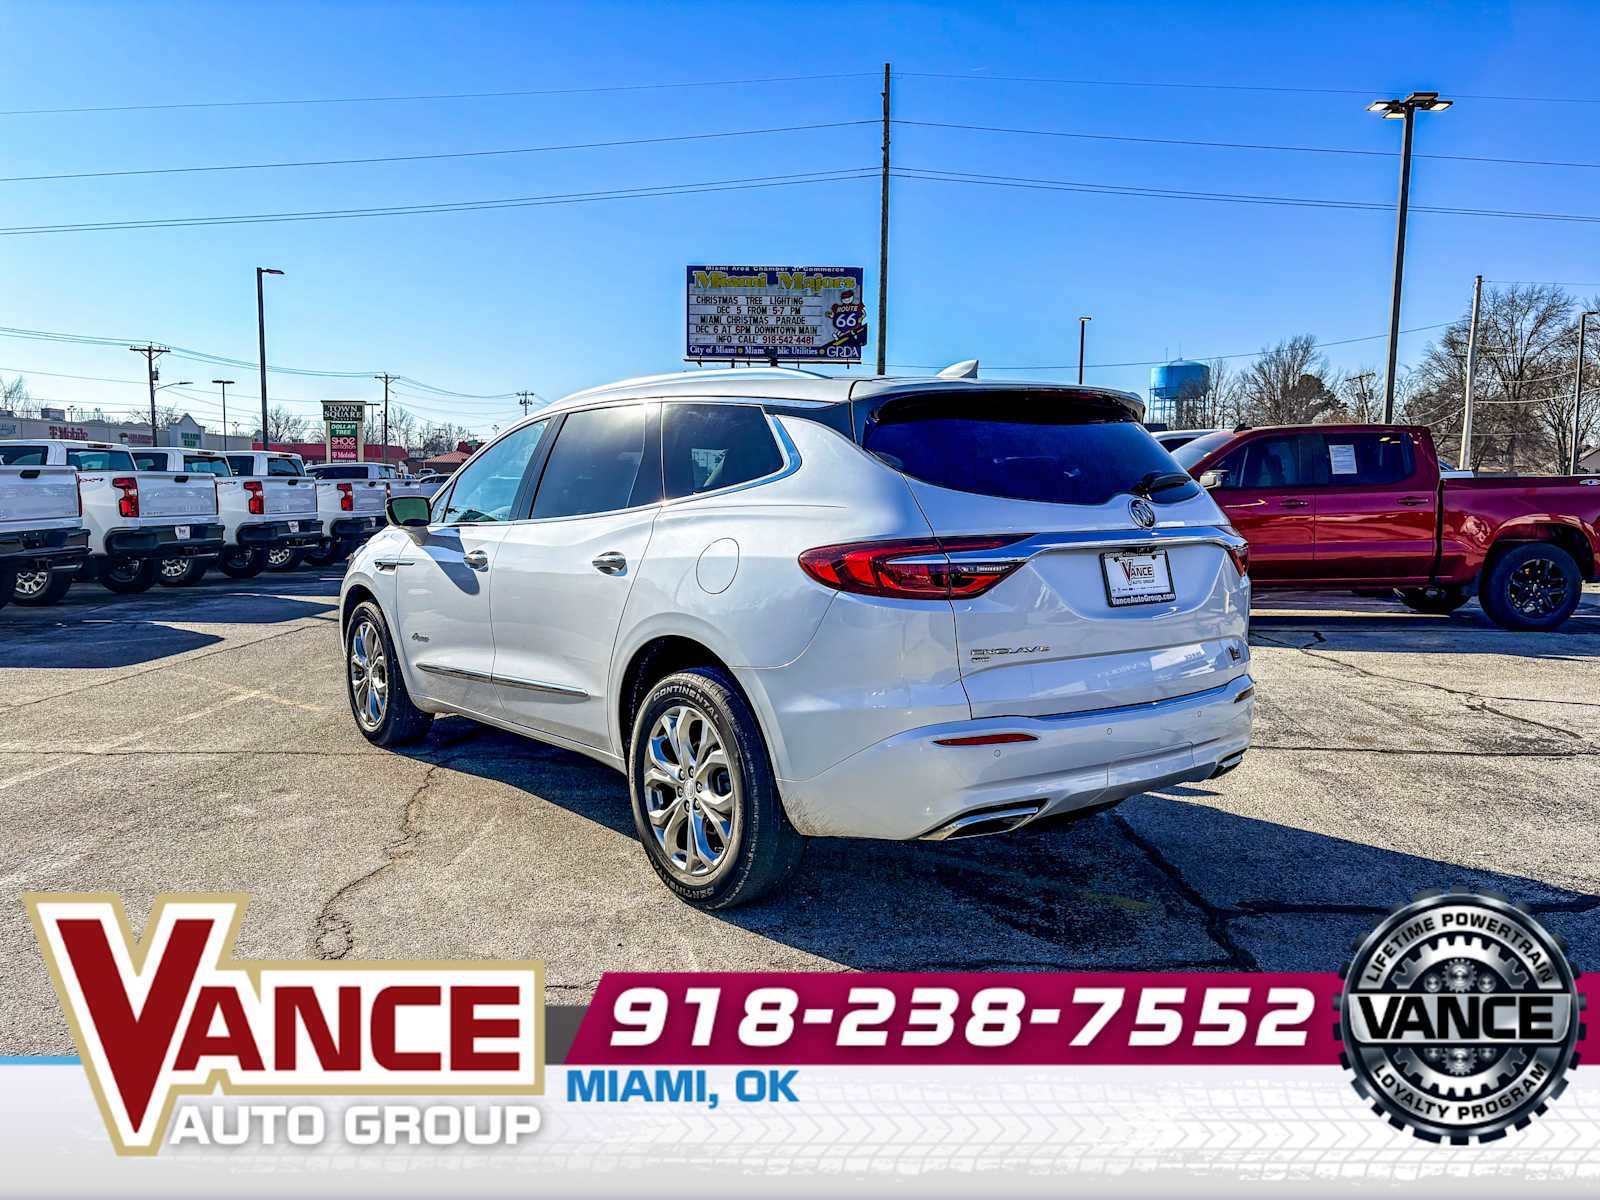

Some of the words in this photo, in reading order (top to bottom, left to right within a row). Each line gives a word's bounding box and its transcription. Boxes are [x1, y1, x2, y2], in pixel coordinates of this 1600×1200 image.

[693, 271, 767, 289] Miami
[776, 272, 857, 294] Majors
[696, 296, 739, 305] CHRISTMAS
[746, 296, 763, 305] TREE
[769, 296, 804, 305] LIGHTING
[717, 306, 730, 314] DEC
[736, 306, 742, 314] 5
[748, 306, 767, 315] FROM
[791, 307, 801, 315] PM
[837, 305, 858, 313] ROUTE
[701, 315, 722, 324] MIAMI
[727, 316, 769, 325] CHRISTMAS
[776, 316, 806, 325] PARADE
[836, 313, 857, 328] 66
[696, 325, 709, 333] DEC
[713, 326, 719, 334] 6
[722, 326, 732, 334] AT
[735, 326, 751, 334] 6PM
[755, 326, 796, 335] DOWNTOWN
[799, 326, 818, 335] MAIN
[716, 335, 732, 343] INFO
[738, 335, 757, 343] CALL
[690, 345, 704, 354] City
[706, 345, 713, 353] of
[716, 346, 737, 354] Miami
[745, 346, 767, 354] Miam
[791, 346, 818, 355] Utilities
[826, 346, 859, 357] GRDA
[1120, 560, 1153, 585] VANCE
[1111, 593, 1176, 605] VanceAutoGroup.com
[653, 685, 720, 726] CONTINENTAL
